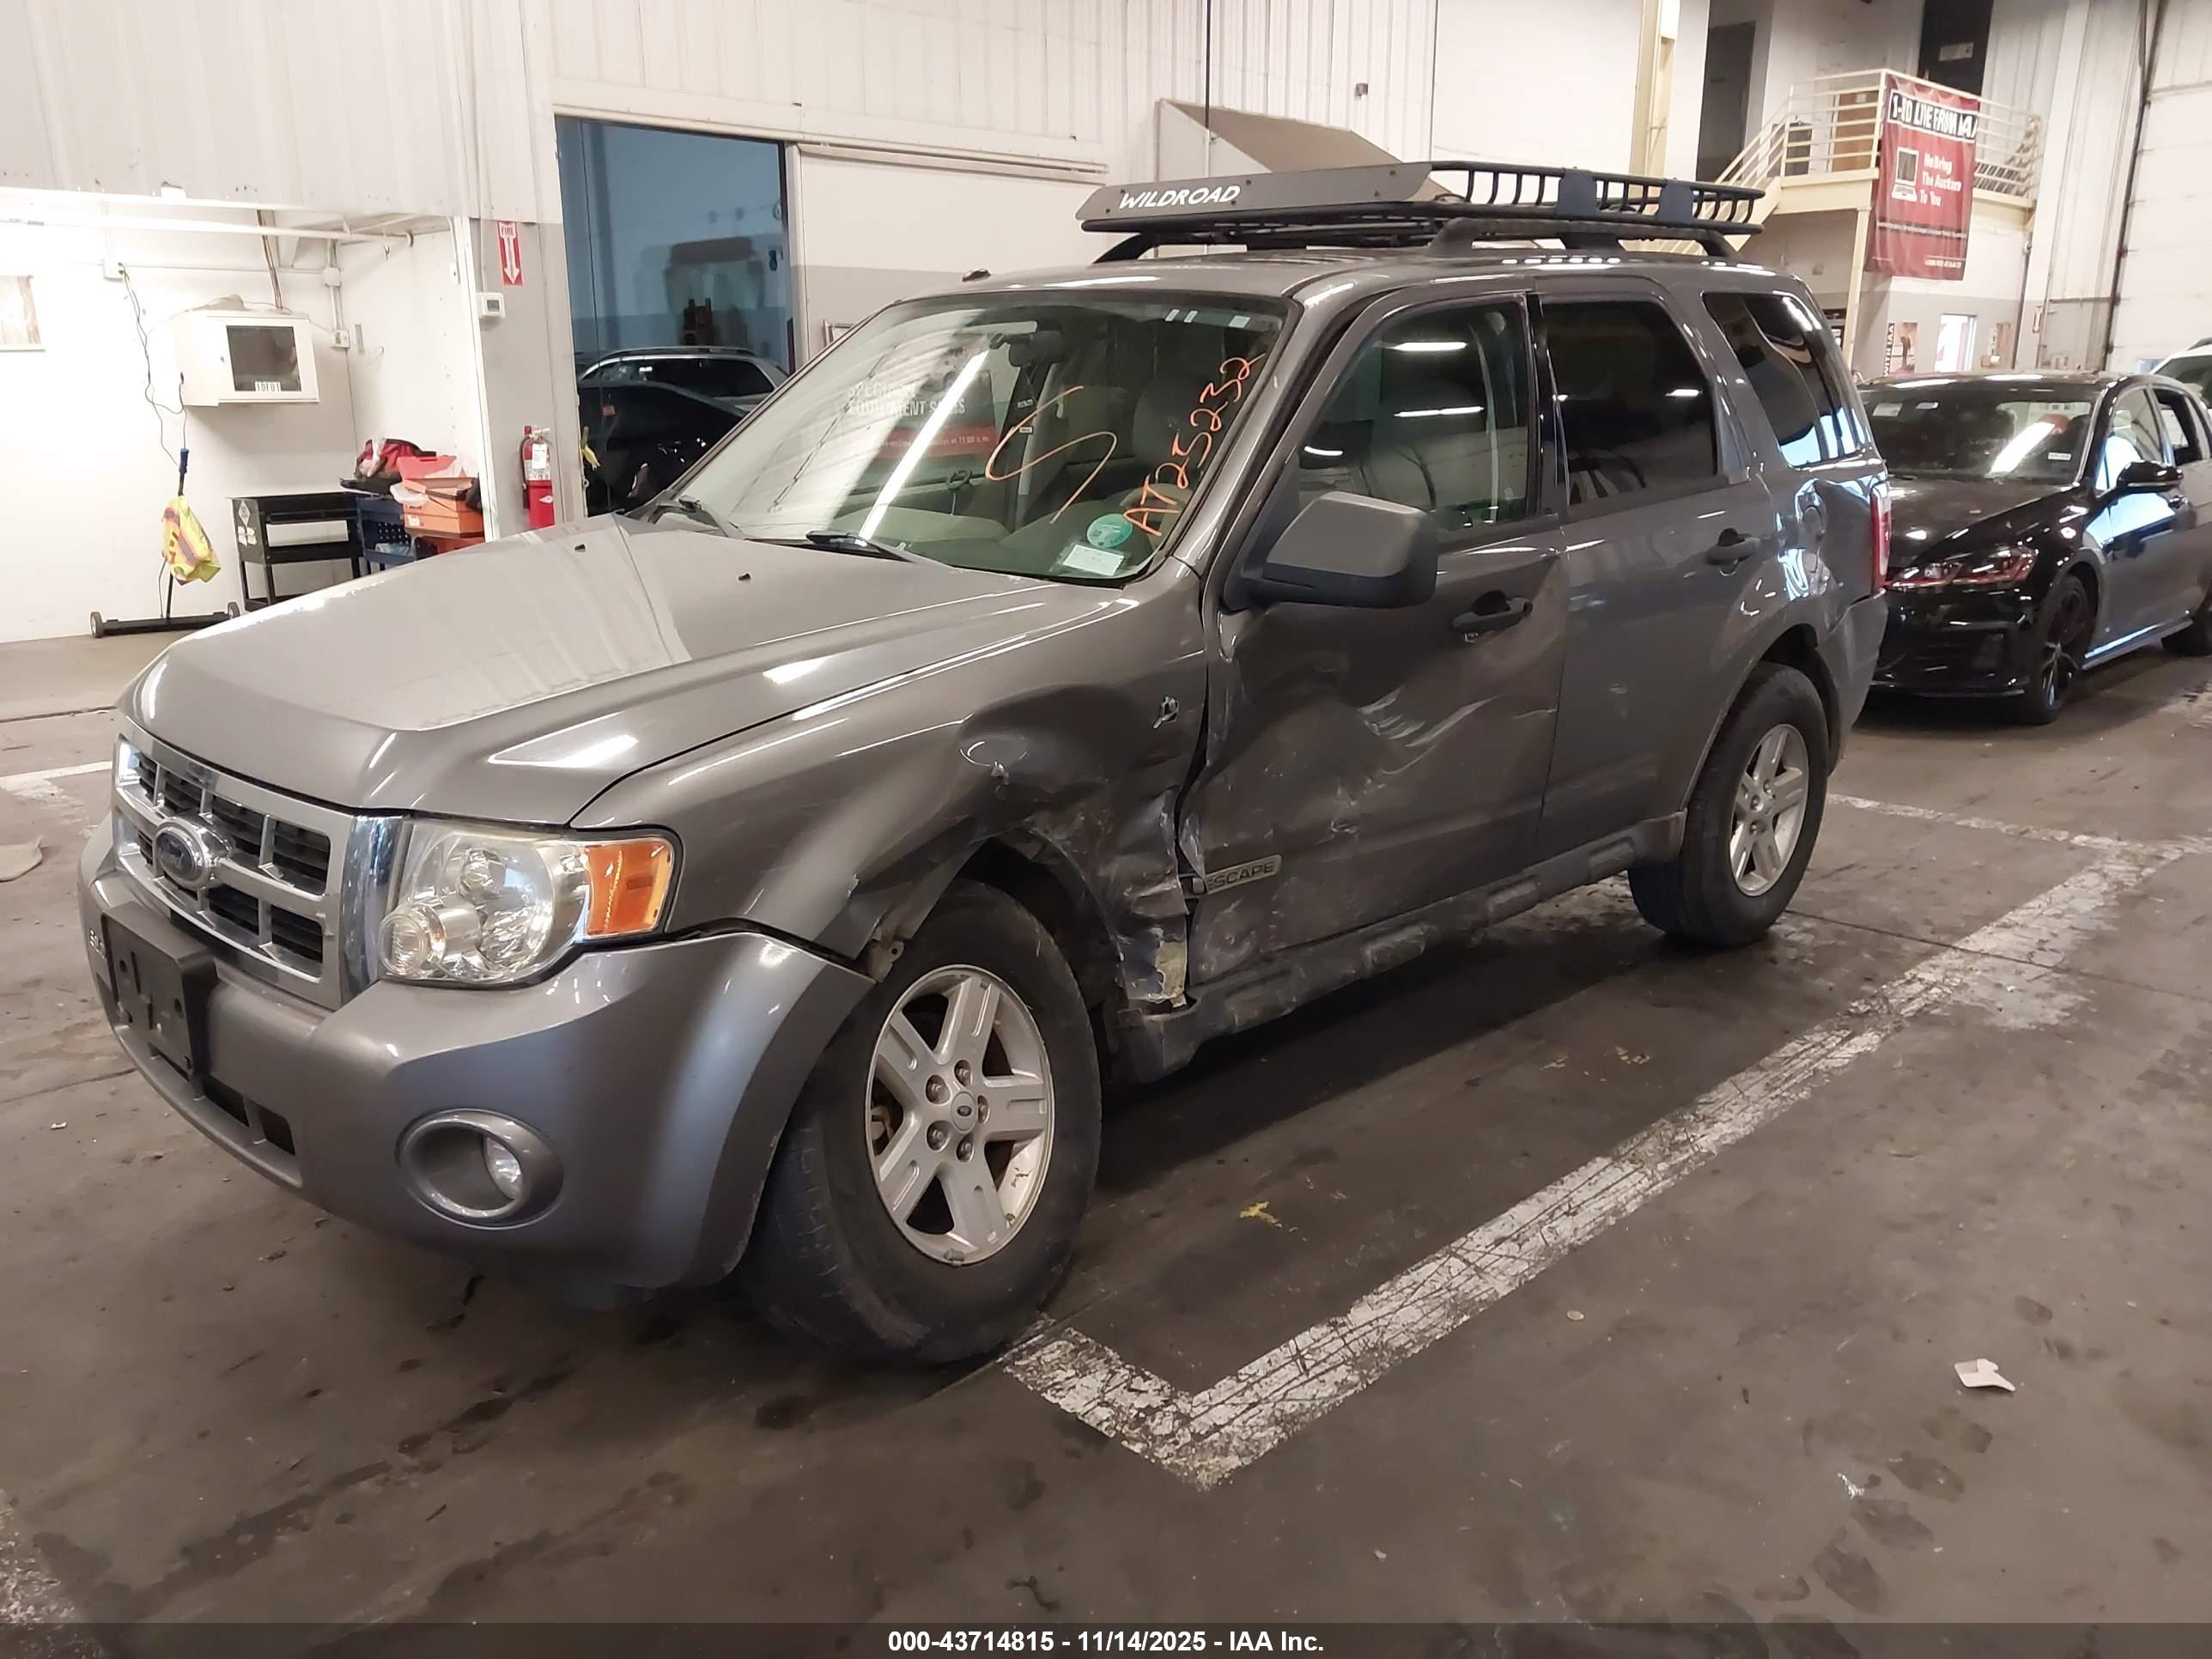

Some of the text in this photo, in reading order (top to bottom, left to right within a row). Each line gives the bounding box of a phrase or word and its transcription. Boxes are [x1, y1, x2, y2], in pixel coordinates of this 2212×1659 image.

[1913, 102, 1933, 129] LIVE
[1932, 106, 1958, 135] FROM
[1923, 171, 1934, 186] The
[1119, 185, 1241, 209] WILDROAD
[1919, 189, 1942, 206] To You
[1206, 861, 1276, 891] ESCAPE
